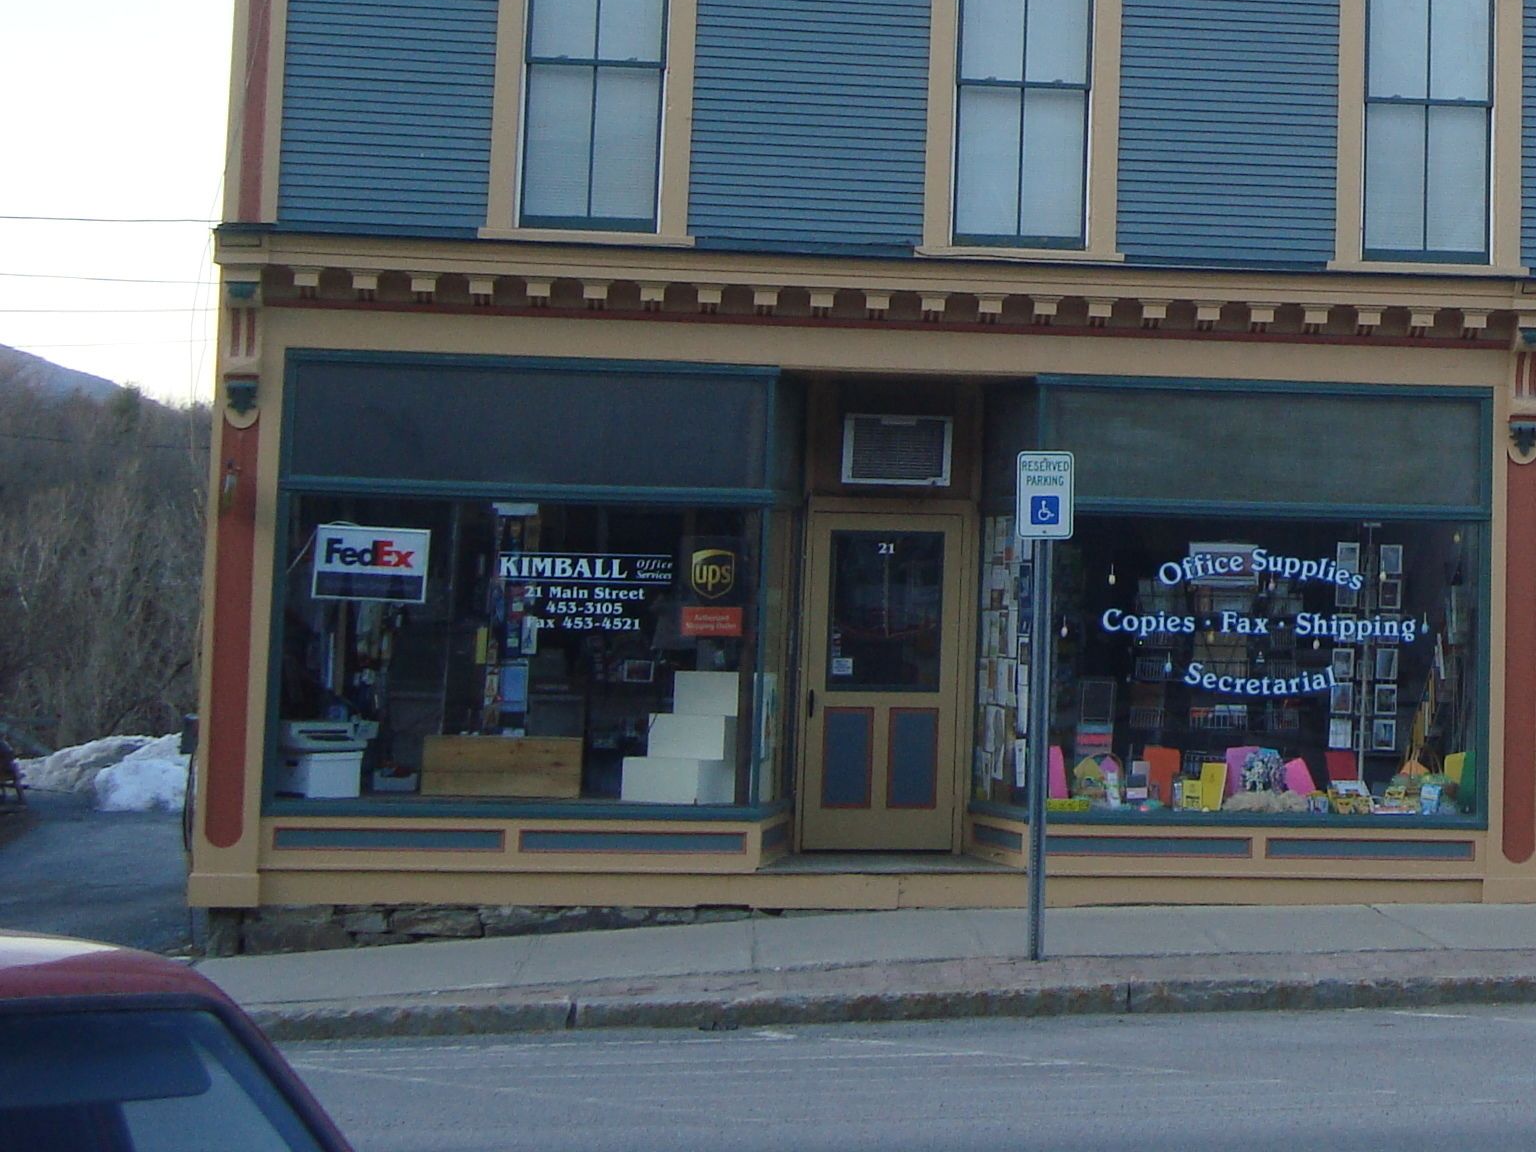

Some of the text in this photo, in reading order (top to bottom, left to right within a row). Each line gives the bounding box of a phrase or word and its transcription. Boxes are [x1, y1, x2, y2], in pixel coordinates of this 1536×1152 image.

[1021, 460, 1070, 472] RESERVED
[1026, 475, 1065, 487] PARKING
[324, 537, 416, 568] FedEx
[877, 542, 895, 554] 21
[499, 555, 628, 579] KIMBALL
[636, 559, 673, 569] Office
[1158, 548, 1364, 590] Office Supplies
[635, 570, 673, 580] Services
[695, 564, 731, 591] ups
[524, 585, 646, 600] 21 Main Street
[545, 601, 623, 615] 453-3105
[526, 616, 641, 630] Fax 453-4521
[1102, 608, 1417, 642] Copies Fax Shipping
[1183, 662, 1338, 695] Secretarial
